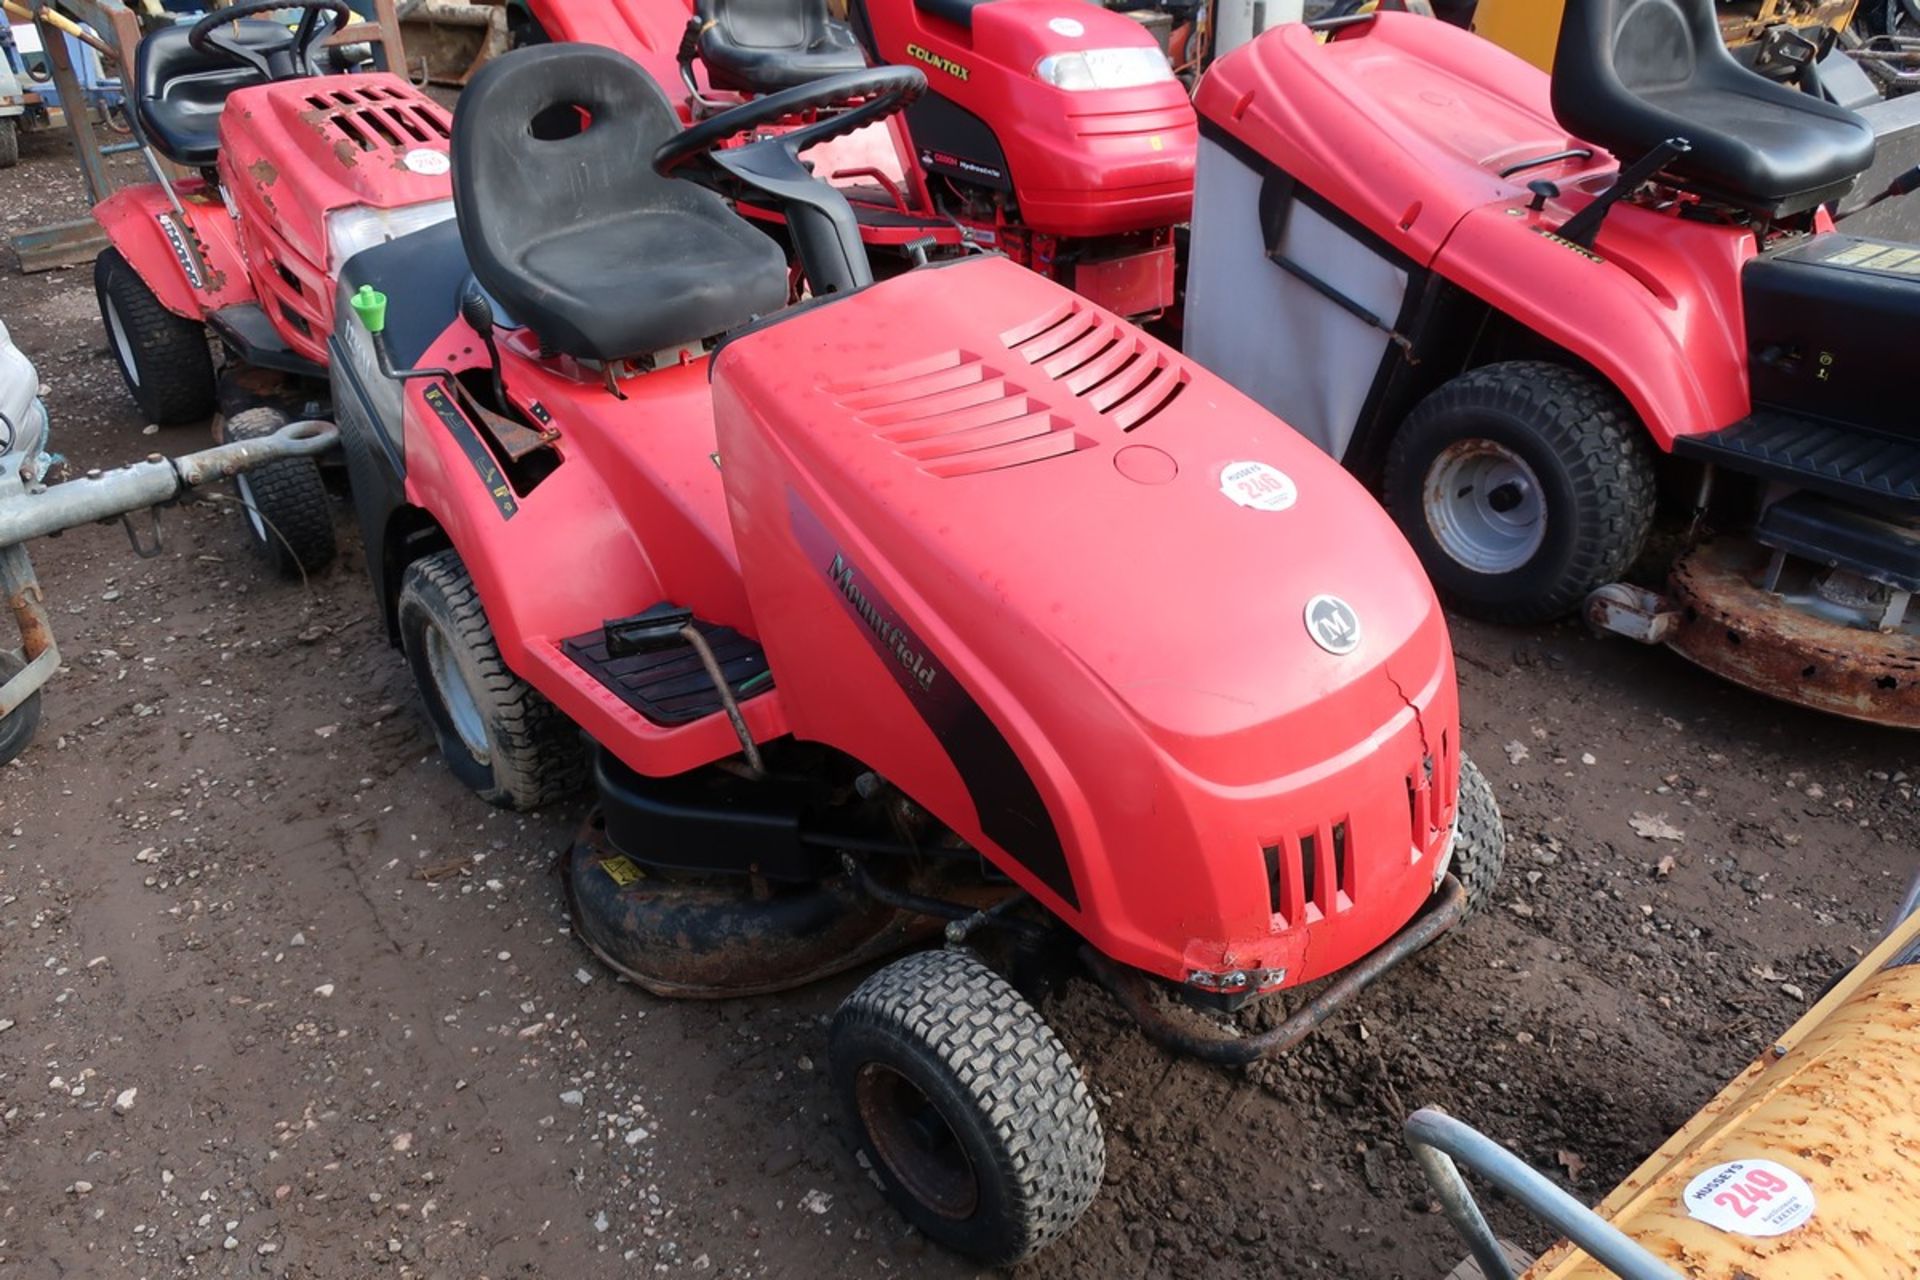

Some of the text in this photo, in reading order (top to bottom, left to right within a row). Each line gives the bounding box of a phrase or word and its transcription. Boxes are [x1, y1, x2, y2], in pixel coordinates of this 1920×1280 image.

[1237, 472, 1283, 499] 246
[827, 552, 936, 692] Mountfield
[1319, 608, 1351, 641] M
[1692, 1163, 1744, 1200] HUSSEYS
[1713, 1168, 1788, 1218] 249
